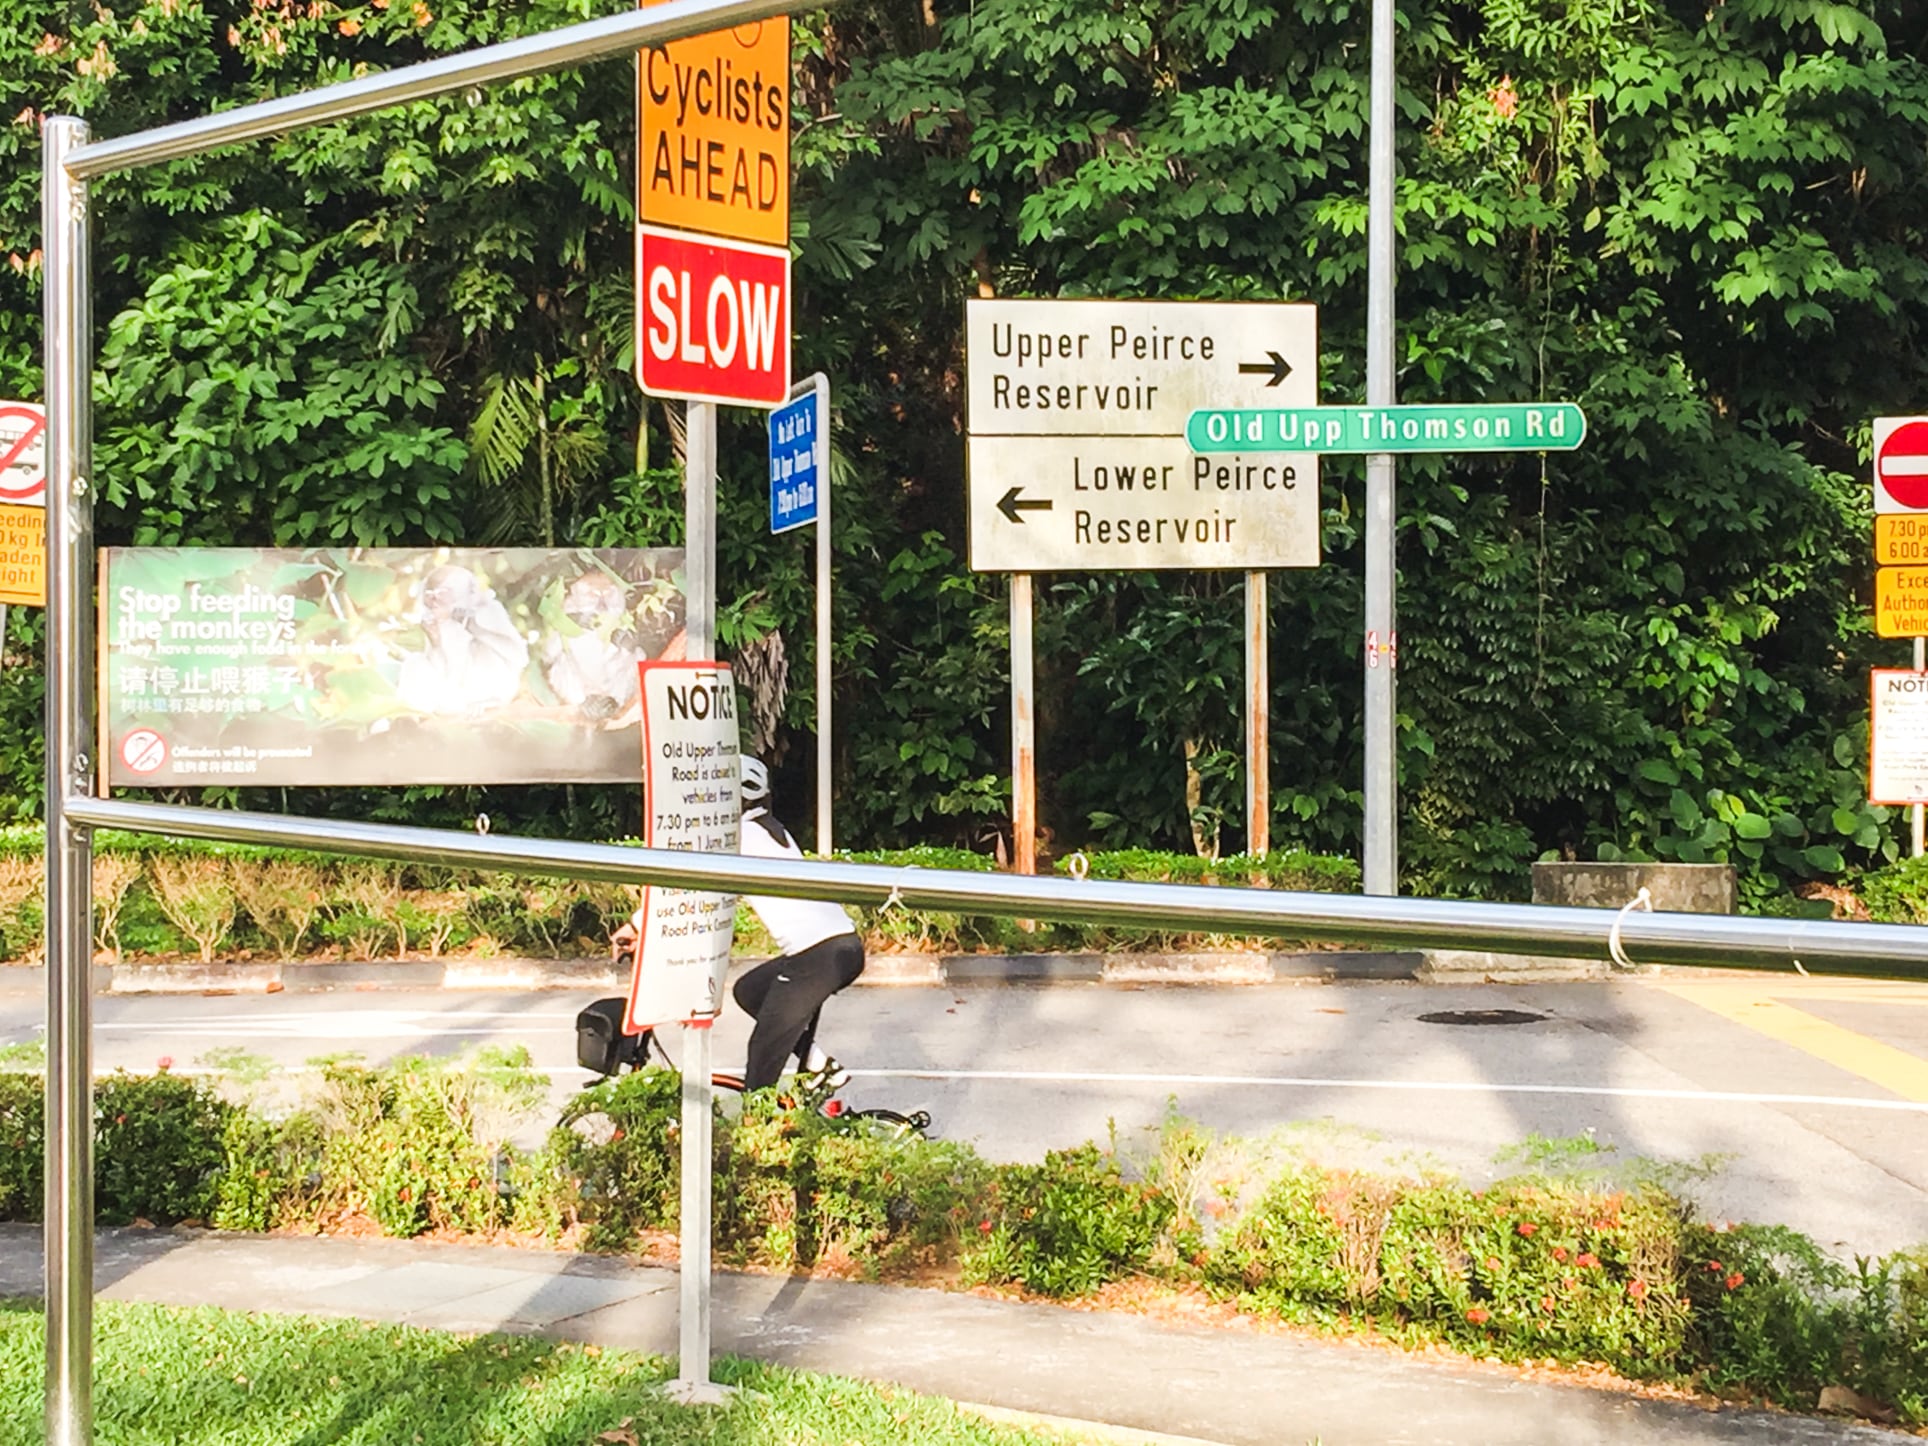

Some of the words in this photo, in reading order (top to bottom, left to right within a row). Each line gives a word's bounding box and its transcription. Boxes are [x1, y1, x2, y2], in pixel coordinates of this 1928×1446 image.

[648, 48, 782, 131] Cyclists
[652, 130, 778, 211] AHEAD
[649, 265, 780, 373] SLOW
[993, 323, 1089, 367] Upper
[1111, 325, 1214, 360] Peirce
[993, 375, 1159, 410] Reservoir
[1207, 413, 1263, 442] Old
[1279, 413, 1343, 447] Upp
[1357, 411, 1511, 441] Thomson
[1526, 410, 1565, 438] Rd
[1074, 457, 1173, 491] Lower
[1194, 456, 1297, 491] Peirce
[9, 530, 28, 549] kg
[1075, 509, 1237, 545] Reservoir
[118, 586, 182, 621] Stop
[189, 583, 295, 621] feeding
[118, 612, 162, 639] the
[171, 611, 296, 648] monkeys
[156, 641, 190, 655] have
[194, 641, 244, 658] enough
[667, 685, 733, 720] NOTICE
[662, 742, 682, 758] Old
[686, 743, 715, 761] Upper
[672, 765, 698, 782] Road
[701, 767, 708, 780] is
[683, 787, 717, 804] vehicles
[657, 815, 682, 830] 7.30
[685, 817, 699, 832] pm
[703, 815, 712, 826] to
[657, 907, 674, 918] use
[678, 901, 695, 917] Old
[661, 921, 689, 939] Road
[692, 919, 714, 935] Park
